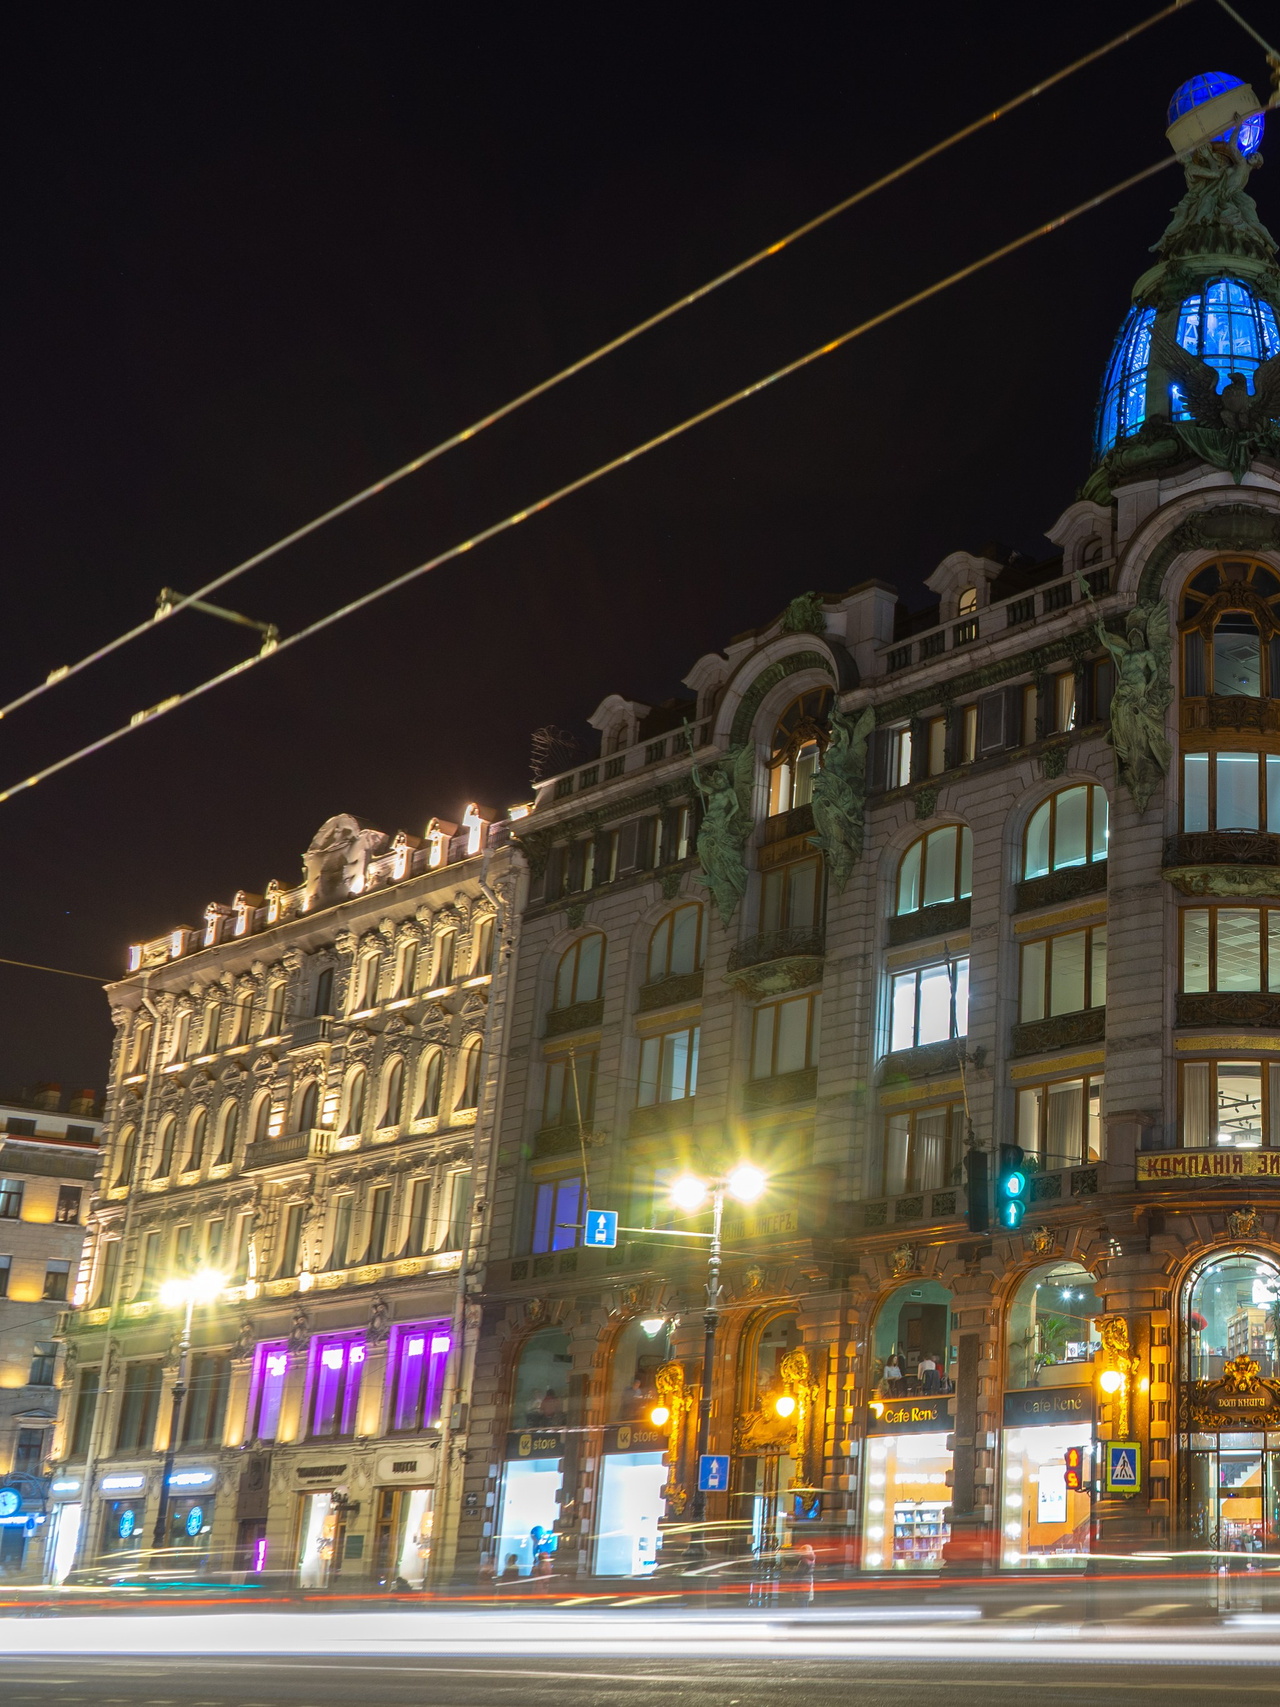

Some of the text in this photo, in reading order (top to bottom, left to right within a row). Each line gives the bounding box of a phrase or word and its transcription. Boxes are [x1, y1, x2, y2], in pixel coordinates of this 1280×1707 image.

[1147, 1154, 1243, 1178] КОМПАНІЯ
[1023, 1393, 1082, 1414] Cafe René
[1219, 1398, 1236, 1407] ДОМ
[884, 1404, 938, 1424] Cafe René
[533, 1437, 557, 1450] store
[633, 1429, 658, 1443] store
